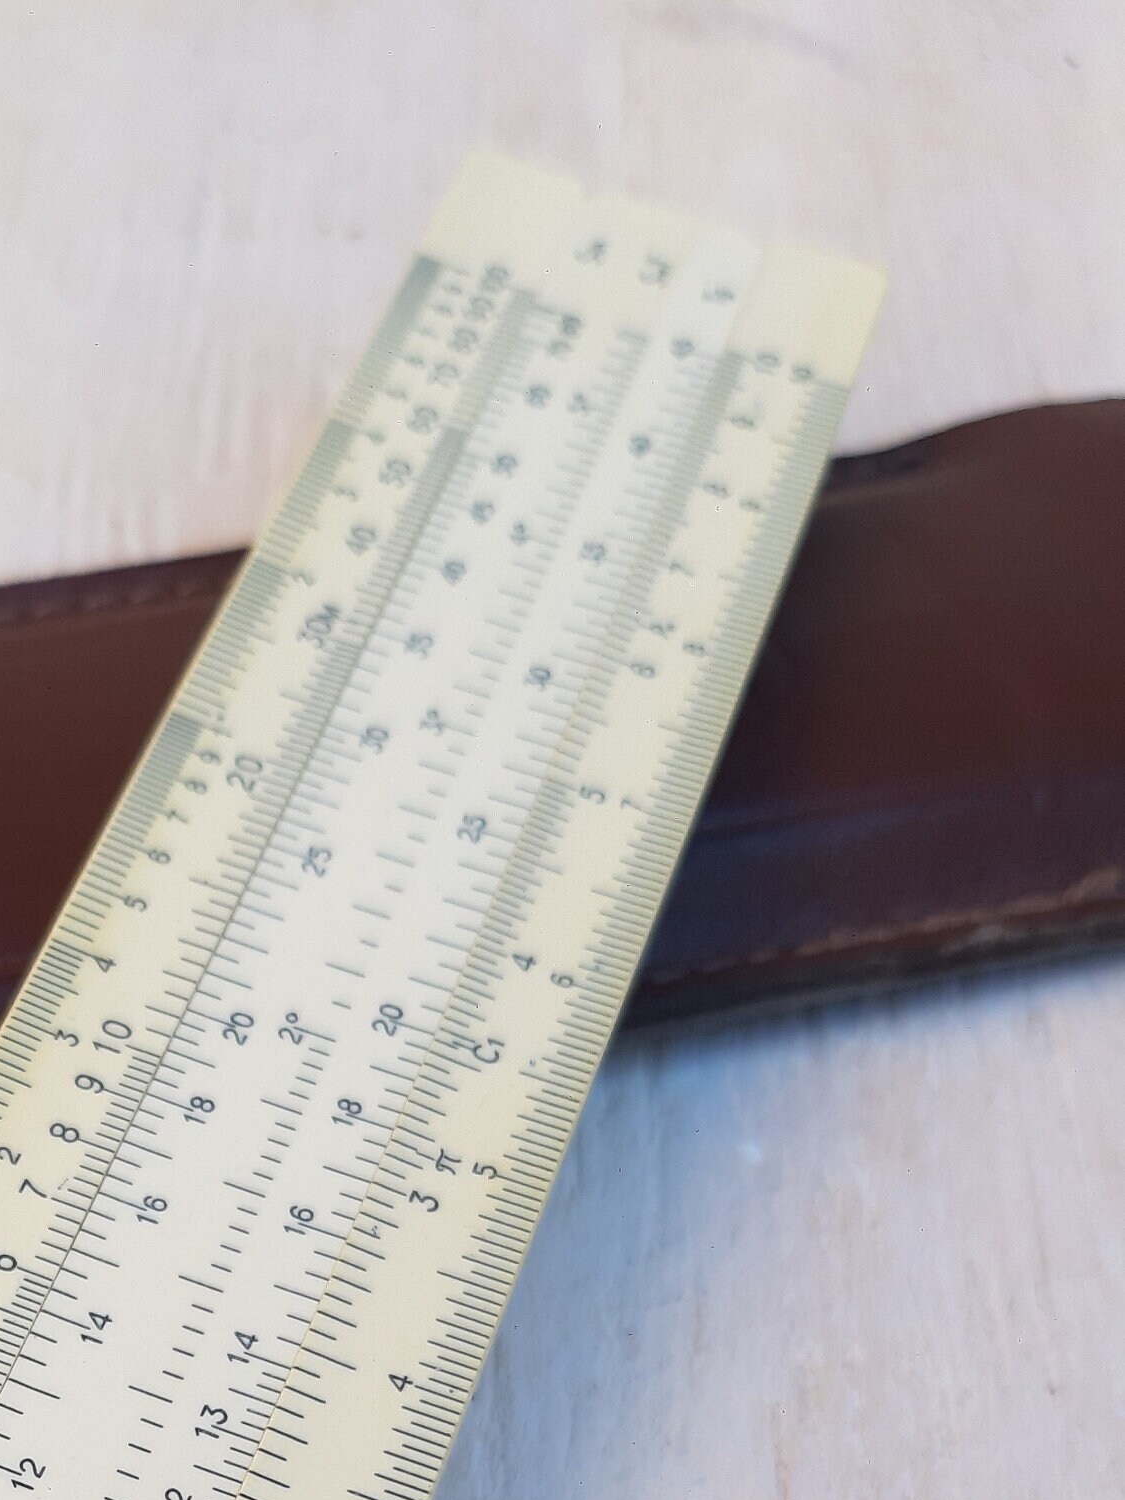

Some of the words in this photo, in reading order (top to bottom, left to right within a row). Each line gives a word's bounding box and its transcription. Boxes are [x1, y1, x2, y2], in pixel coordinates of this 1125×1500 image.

[359, 726, 390, 754] 30
[226, 755, 264, 791] 20
[580, 786, 605, 804] 5
[457, 815, 487, 844] 25
[148, 849, 172, 865] 6
[303, 846, 332, 877] 25
[123, 895, 147, 912] 5
[91, 954, 116, 972] 4
[512, 954, 536, 971] 4
[550, 972, 574, 988] 6
[222, 1012, 254, 1046] 20
[372, 1003, 405, 1037] 20
[54, 1029, 80, 1047] 3
[92, 1019, 133, 1054] 10
[74, 1074, 104, 1094] 9
[183, 1095, 215, 1124] 18
[331, 1099, 363, 1127] 18
[49, 1123, 79, 1143] 8
[474, 1164, 499, 1180] 5
[18, 1178, 48, 1198] 7
[409, 1190, 440, 1212] 3
[136, 1195, 167, 1225] 16
[283, 1205, 314, 1235] 16
[80, 1311, 112, 1344] 14
[227, 1331, 259, 1363] 14
[388, 1373, 414, 1391] 4
[194, 1404, 228, 1439] 13
[11, 1457, 46, 1490] 12
